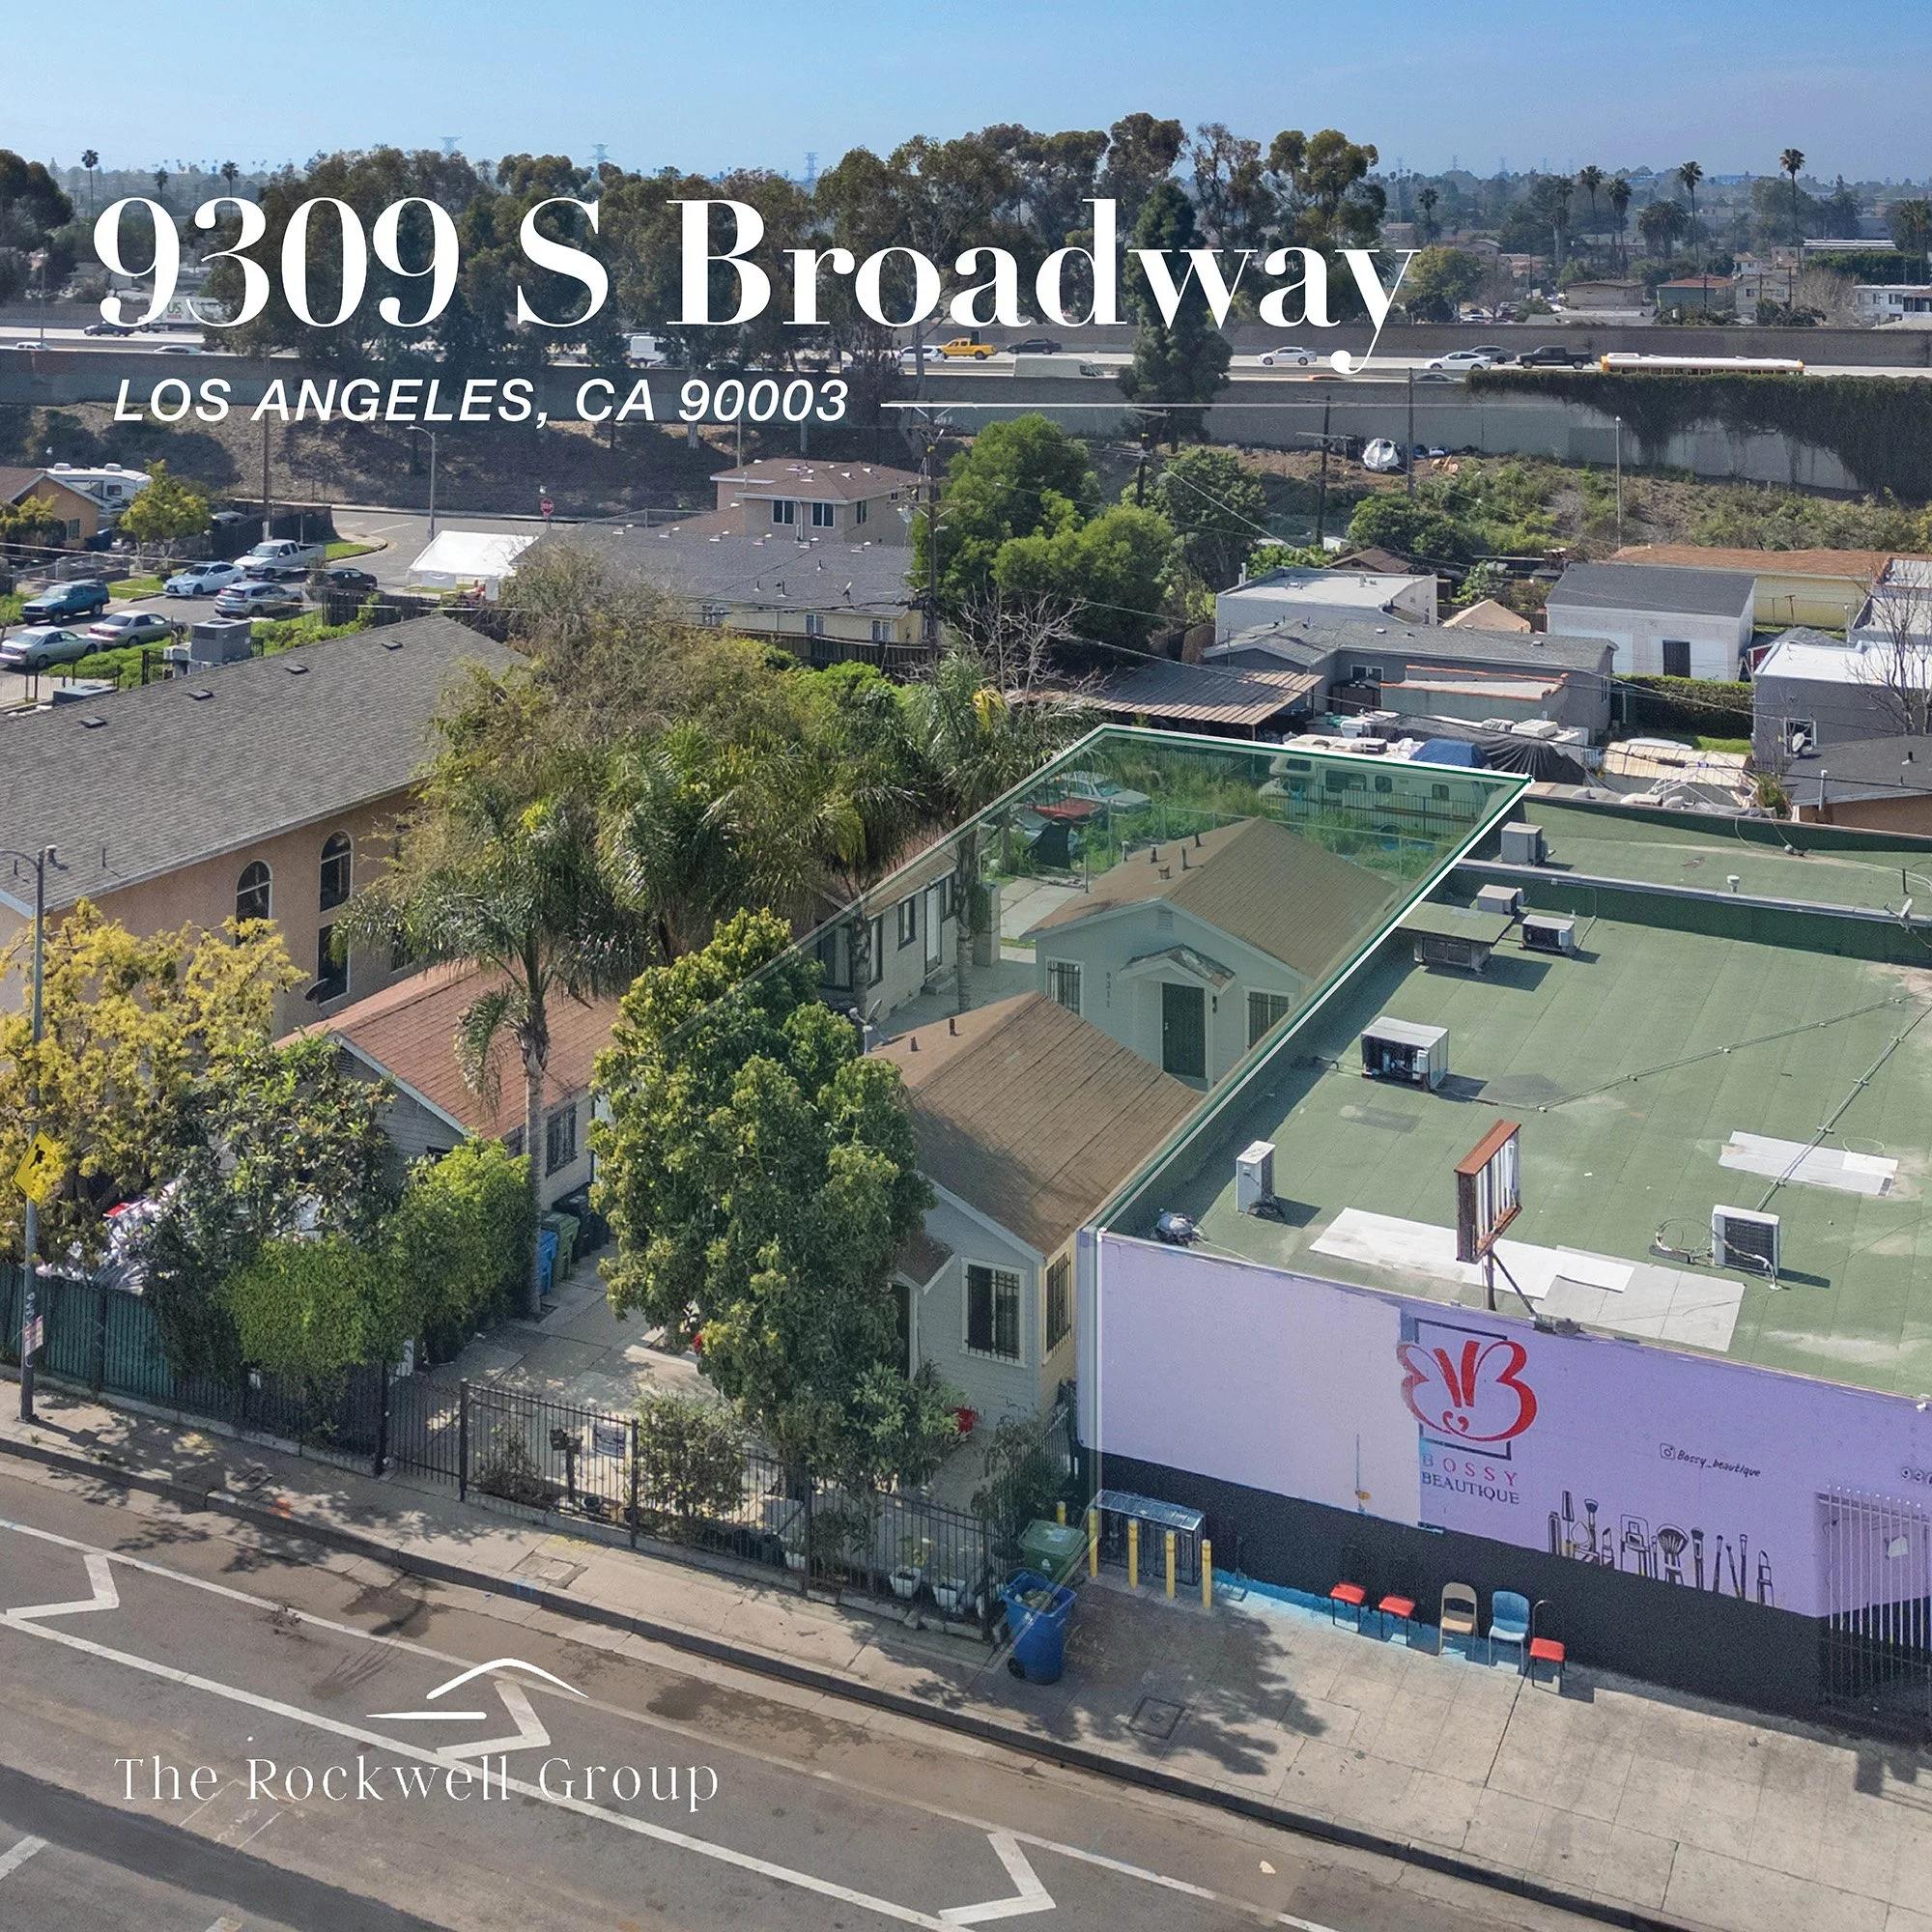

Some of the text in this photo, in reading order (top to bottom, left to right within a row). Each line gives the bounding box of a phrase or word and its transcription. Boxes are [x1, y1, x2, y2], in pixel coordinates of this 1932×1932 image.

[1422, 1453, 1518, 1487] BOSSY
[1677, 1449, 1761, 1478] Bossy_beautique
[1421, 1471, 1520, 1505] BEAUTIQUE
